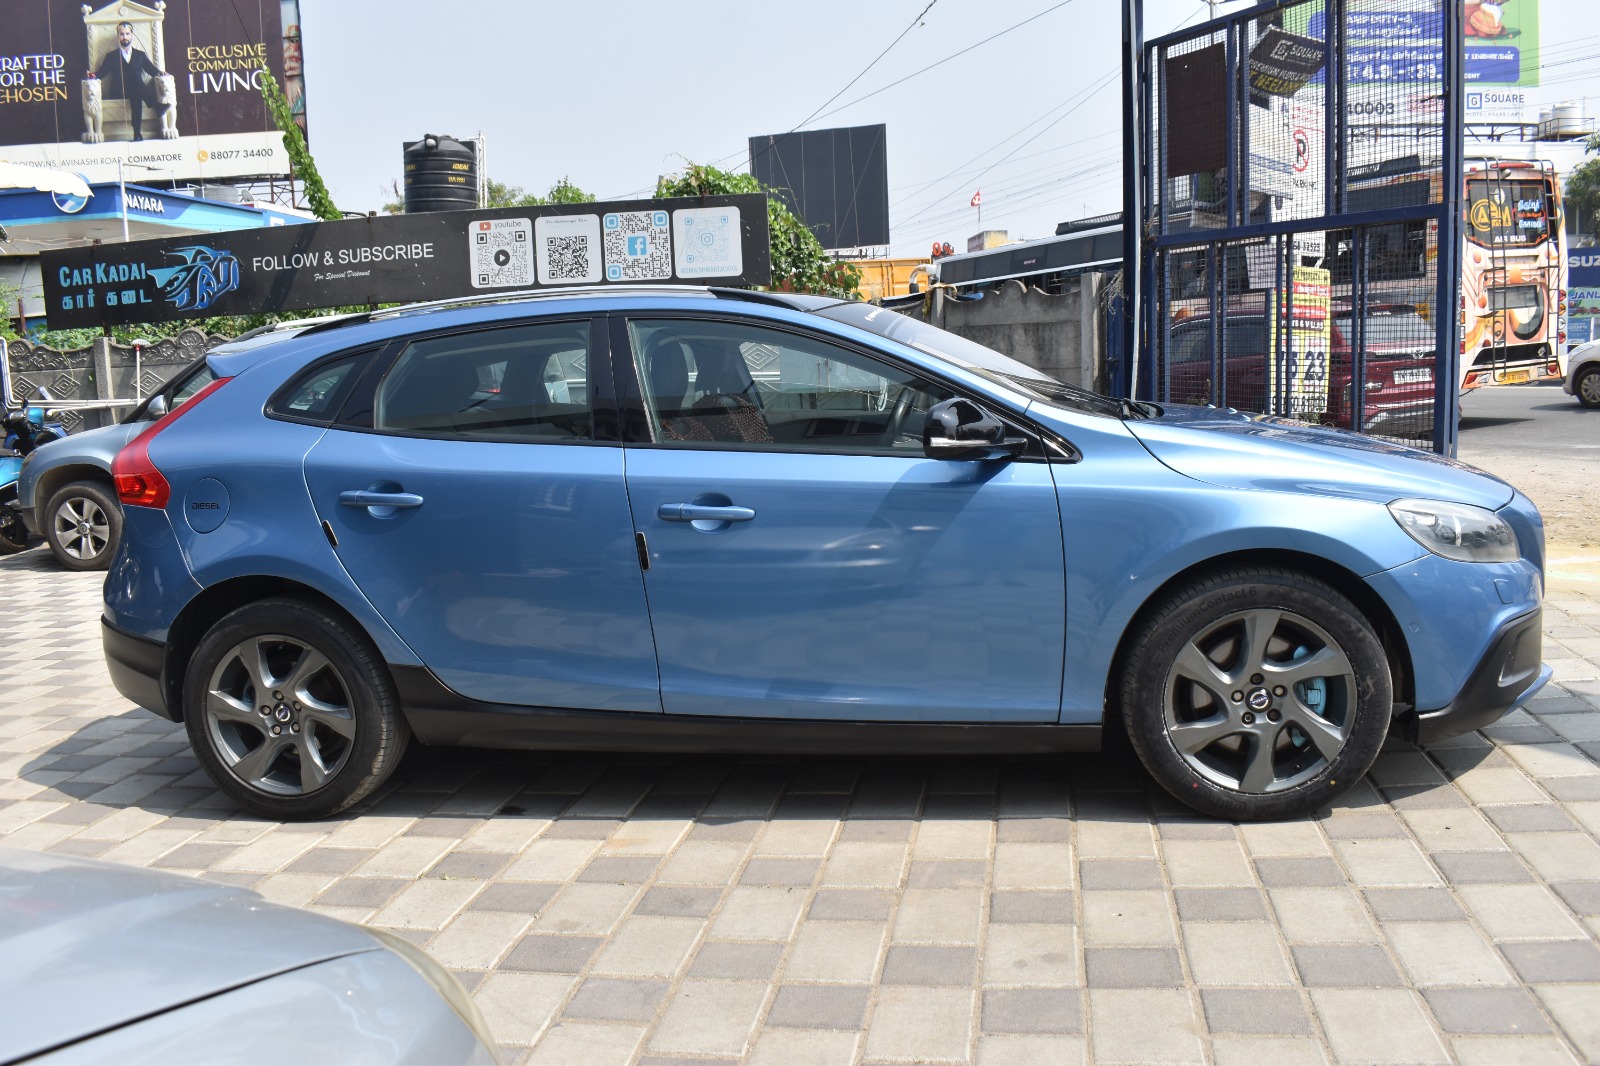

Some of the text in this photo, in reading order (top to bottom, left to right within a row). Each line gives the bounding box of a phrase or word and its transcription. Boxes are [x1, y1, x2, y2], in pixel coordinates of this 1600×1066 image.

[187, 43, 267, 60] EXCLUSIVE
[0, 54, 65, 71] RAFTED
[188, 57, 267, 72] COMMUNITY
[0, 70, 66, 87] OR THE
[1484, 94, 1524, 104] SQUARE
[61, 158, 98, 167] AVINASHI
[128, 153, 182, 164] COIMBATORE
[210, 151, 239, 160] 88077
[243, 148, 273, 158] 34400
[125, 194, 164, 213] NAYARA
[494, 221, 521, 229] youtube
[252, 243, 434, 272] FOLLOW & SUBSCRIBE
[60, 262, 146, 287] CAR KADAI
[314, 269, 371, 282] For Special Discount
[62, 288, 152, 310] கார் கடை
[192, 502, 220, 510] DIESEL
[1248, 586, 1257, 596] 6
